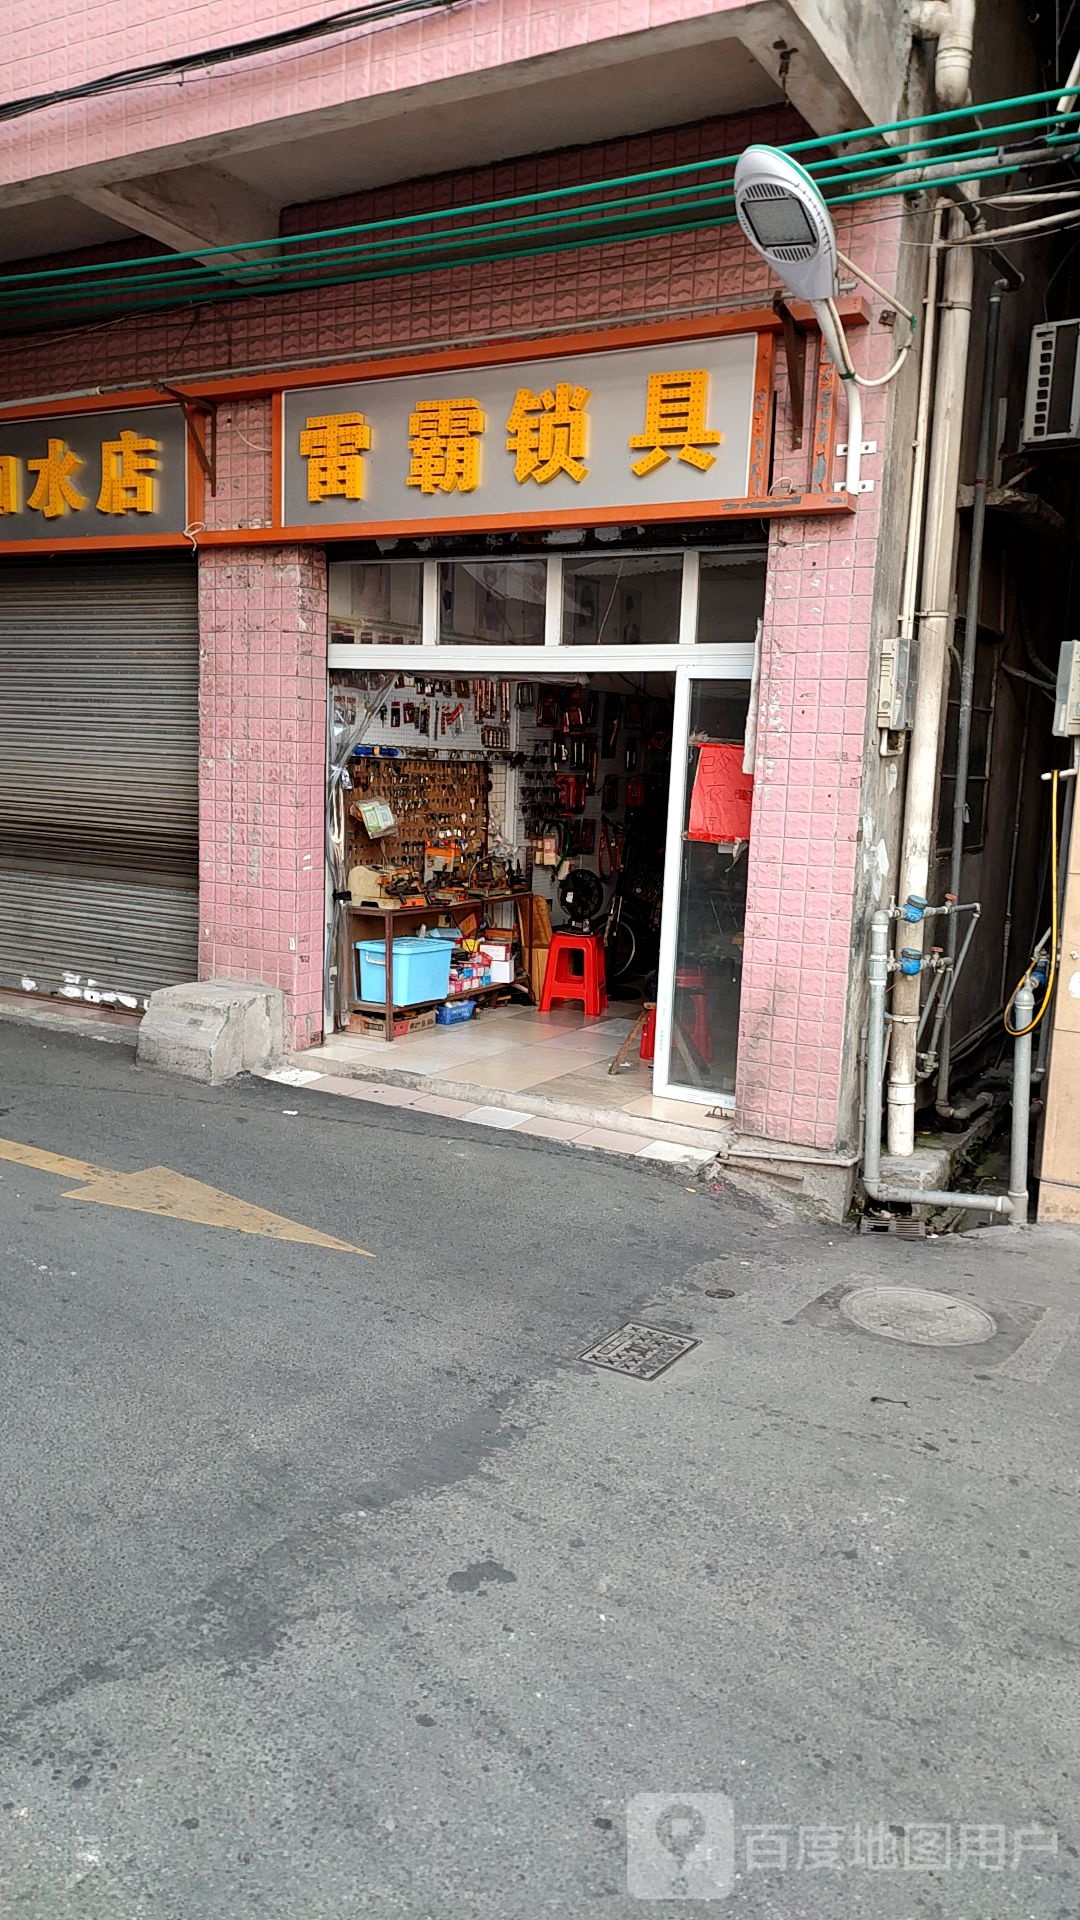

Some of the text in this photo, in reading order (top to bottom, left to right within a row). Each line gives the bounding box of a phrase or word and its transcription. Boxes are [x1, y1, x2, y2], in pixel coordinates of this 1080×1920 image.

[0, 430, 157, 517] 水店
[299, 369, 722, 502] 雷霸锁具
